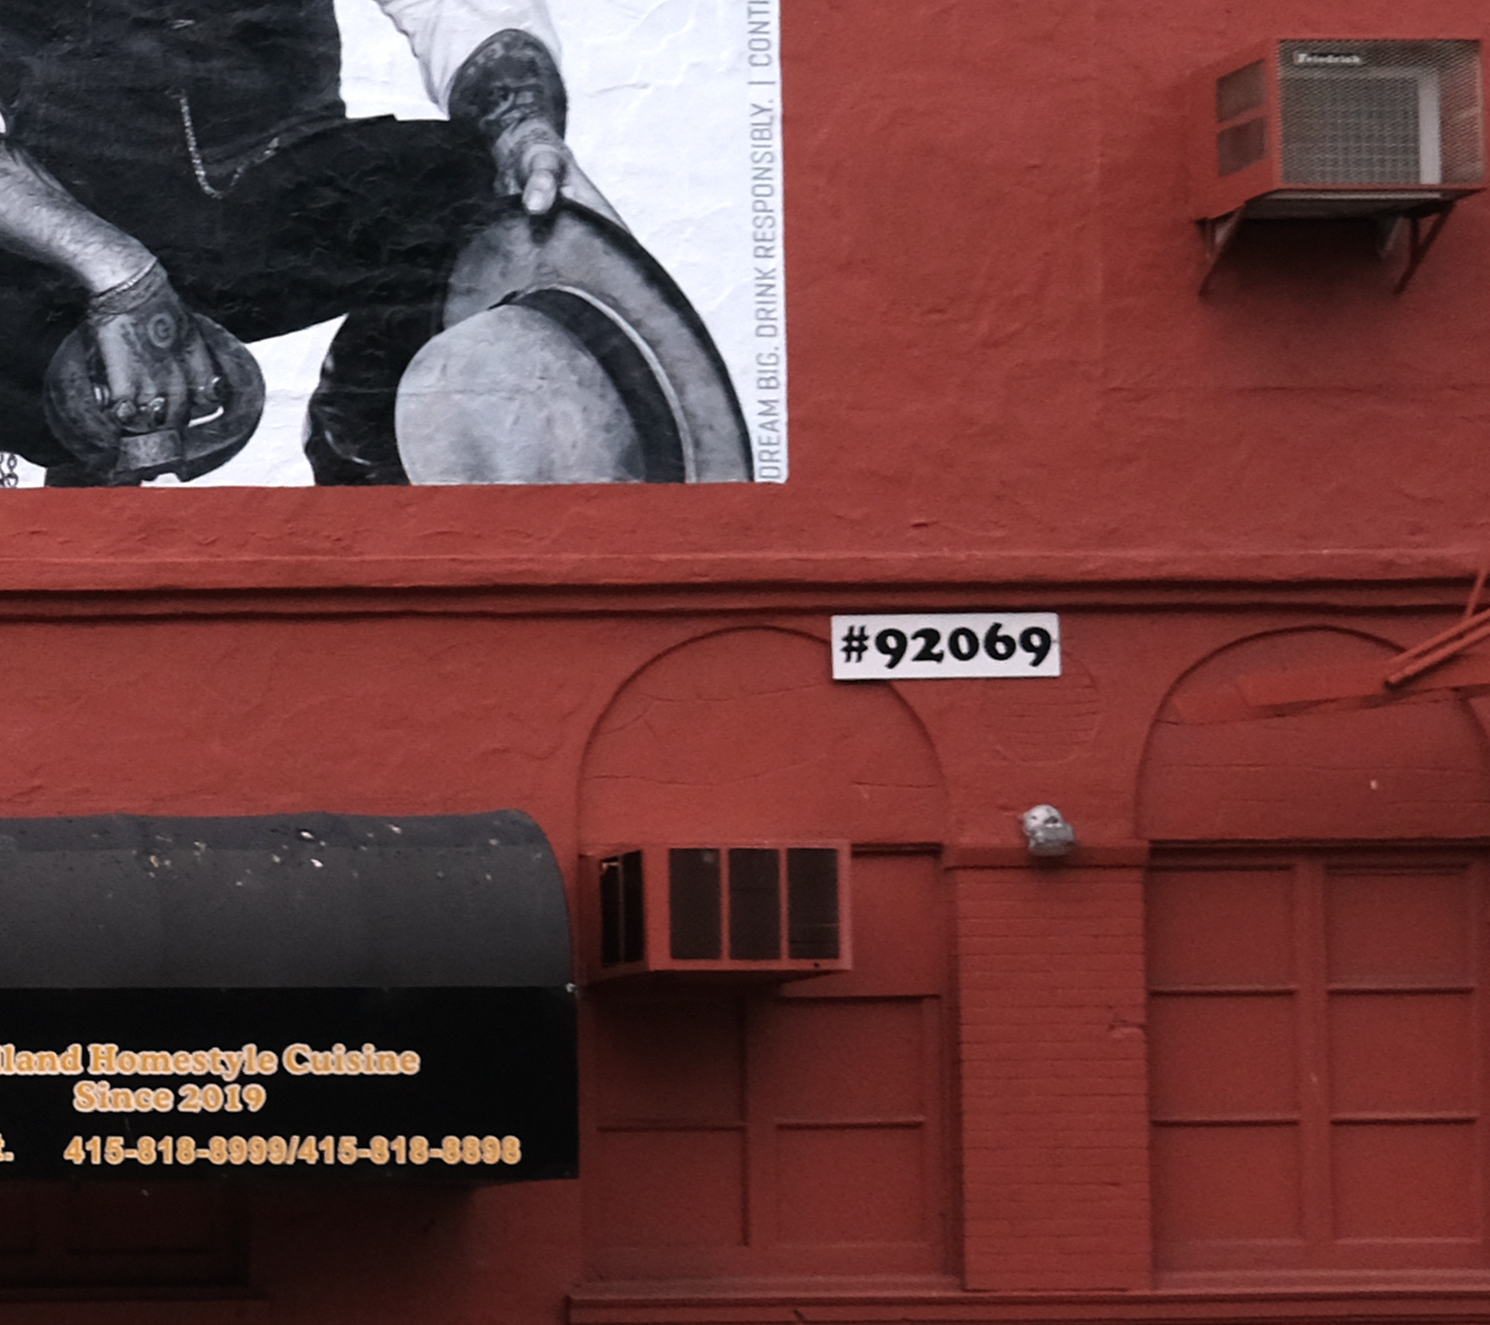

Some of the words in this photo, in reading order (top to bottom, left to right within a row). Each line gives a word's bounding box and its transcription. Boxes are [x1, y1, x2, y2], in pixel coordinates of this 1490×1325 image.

[751, 98, 775, 259] RESPONSIBLY.
[754, 267, 779, 338] DRINK
[755, 346, 781, 391] BIG.
[758, 400, 782, 482] DREAM
[841, 622, 1052, 669] #92069
[86, 1043, 278, 1081] Homestyle
[283, 1043, 421, 1076] Cuisine
[72, 1080, 174, 1113] Since
[178, 1080, 267, 1114] 2019
